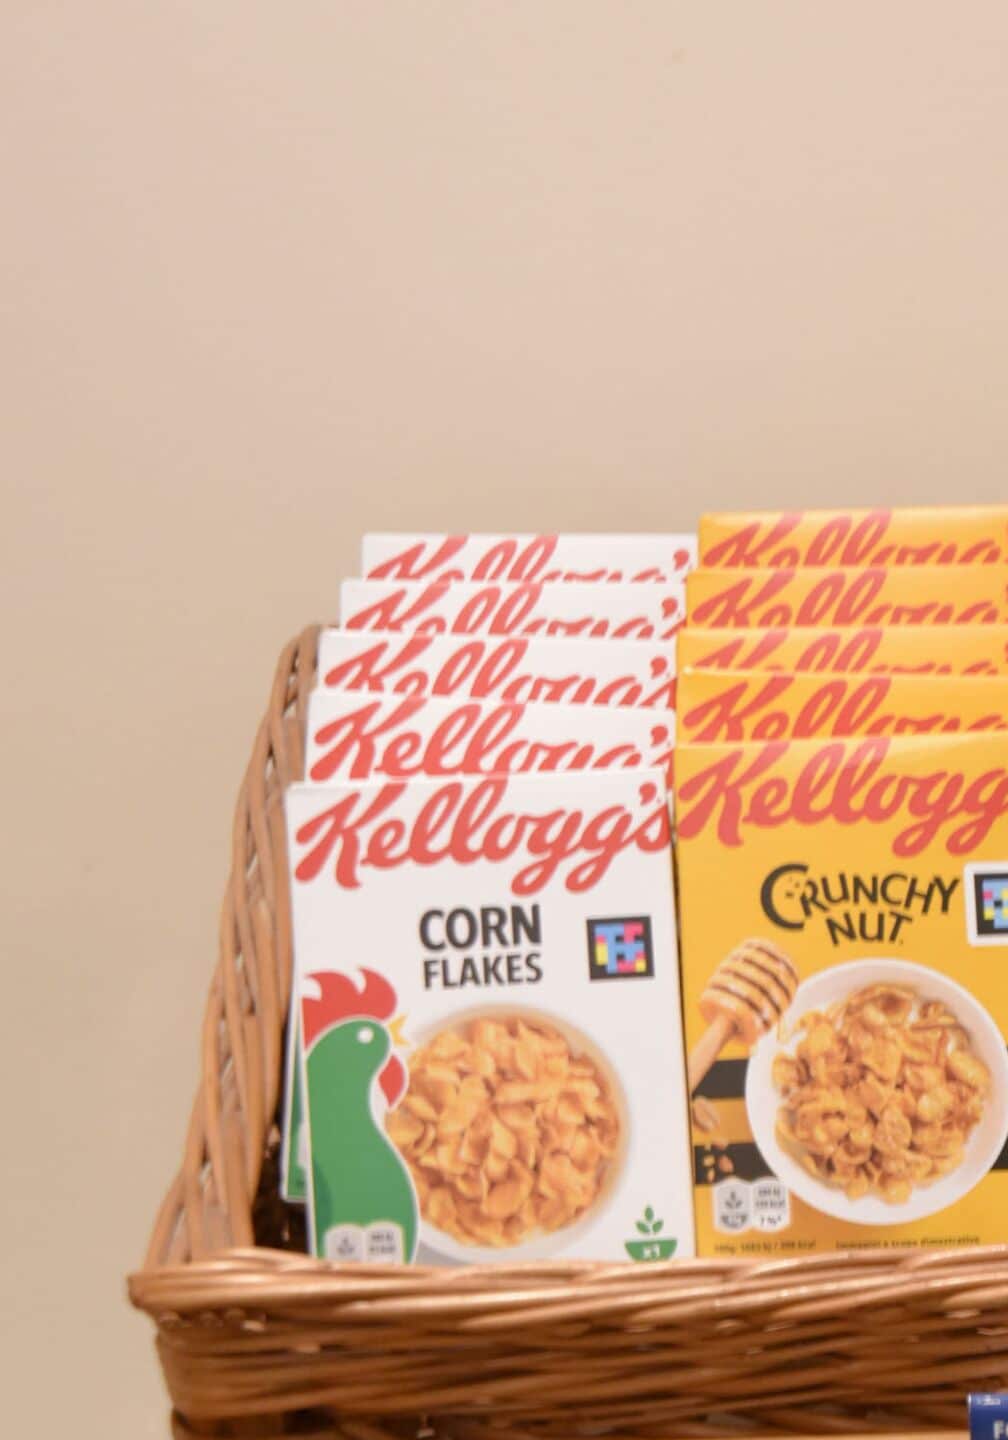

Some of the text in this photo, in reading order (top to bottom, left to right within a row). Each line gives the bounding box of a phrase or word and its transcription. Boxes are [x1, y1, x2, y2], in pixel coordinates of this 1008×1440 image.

[295, 781, 672, 897] Kellogg's
[760, 863, 960, 931] CRUNCHY
[419, 904, 543, 951] CORN
[825, 911, 912, 947] NUT
[424, 953, 544, 990] FLAKES
